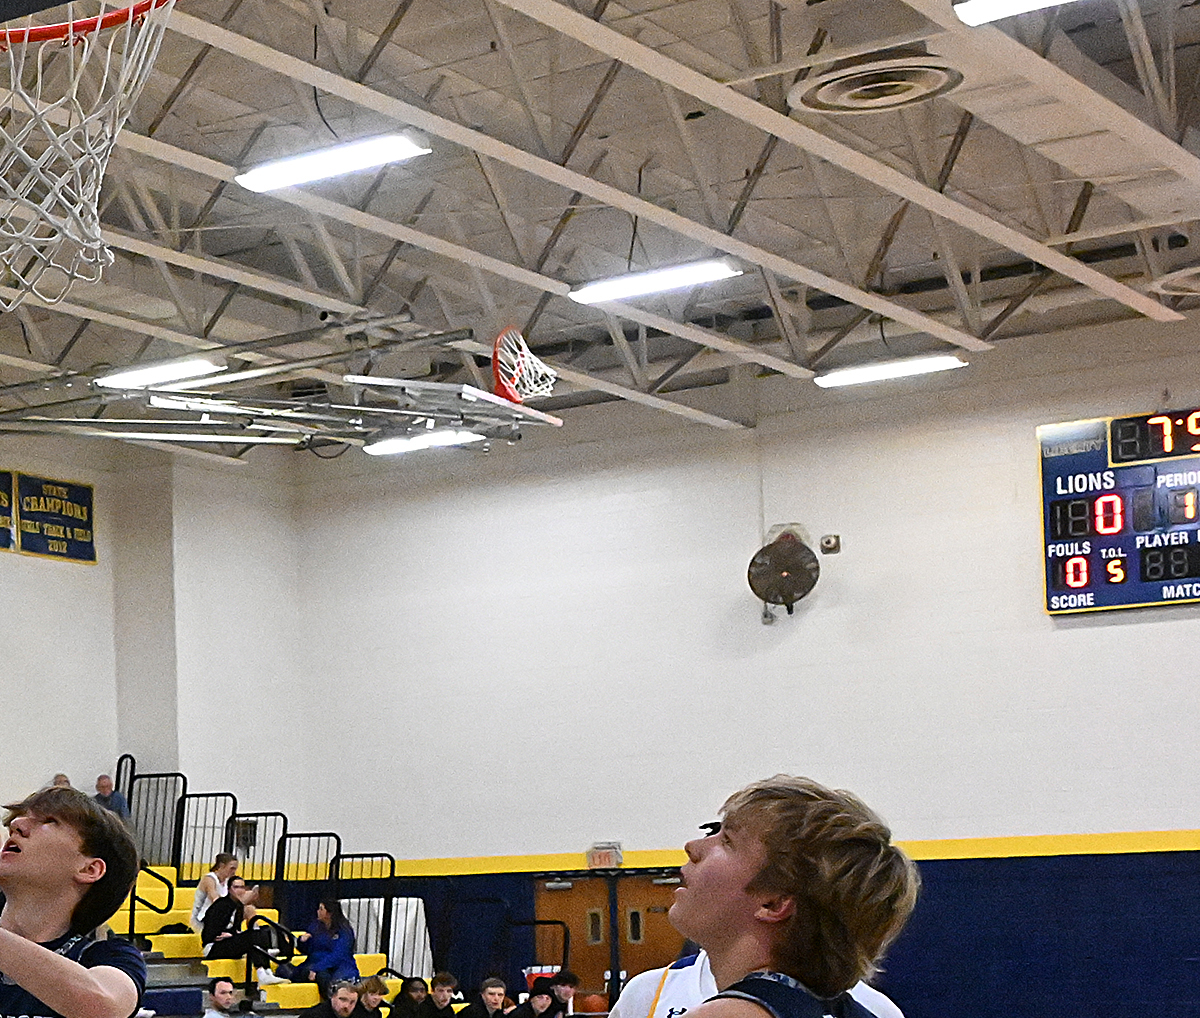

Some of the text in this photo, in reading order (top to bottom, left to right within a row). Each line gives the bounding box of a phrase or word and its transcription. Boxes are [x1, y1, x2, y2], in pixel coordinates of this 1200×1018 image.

[1056, 470, 1115, 495] LIONS
[1157, 470, 1200, 488] PERIO
[22, 496, 88, 521] CHAMPIONS
[1094, 494, 1125, 535] 0
[1184, 492, 1196, 519] 1
[1048, 541, 1091, 557] FOULS
[1136, 531, 1189, 549] PLAYER
[1065, 556, 1090, 588] 0
[1051, 593, 1095, 609] SCORE
